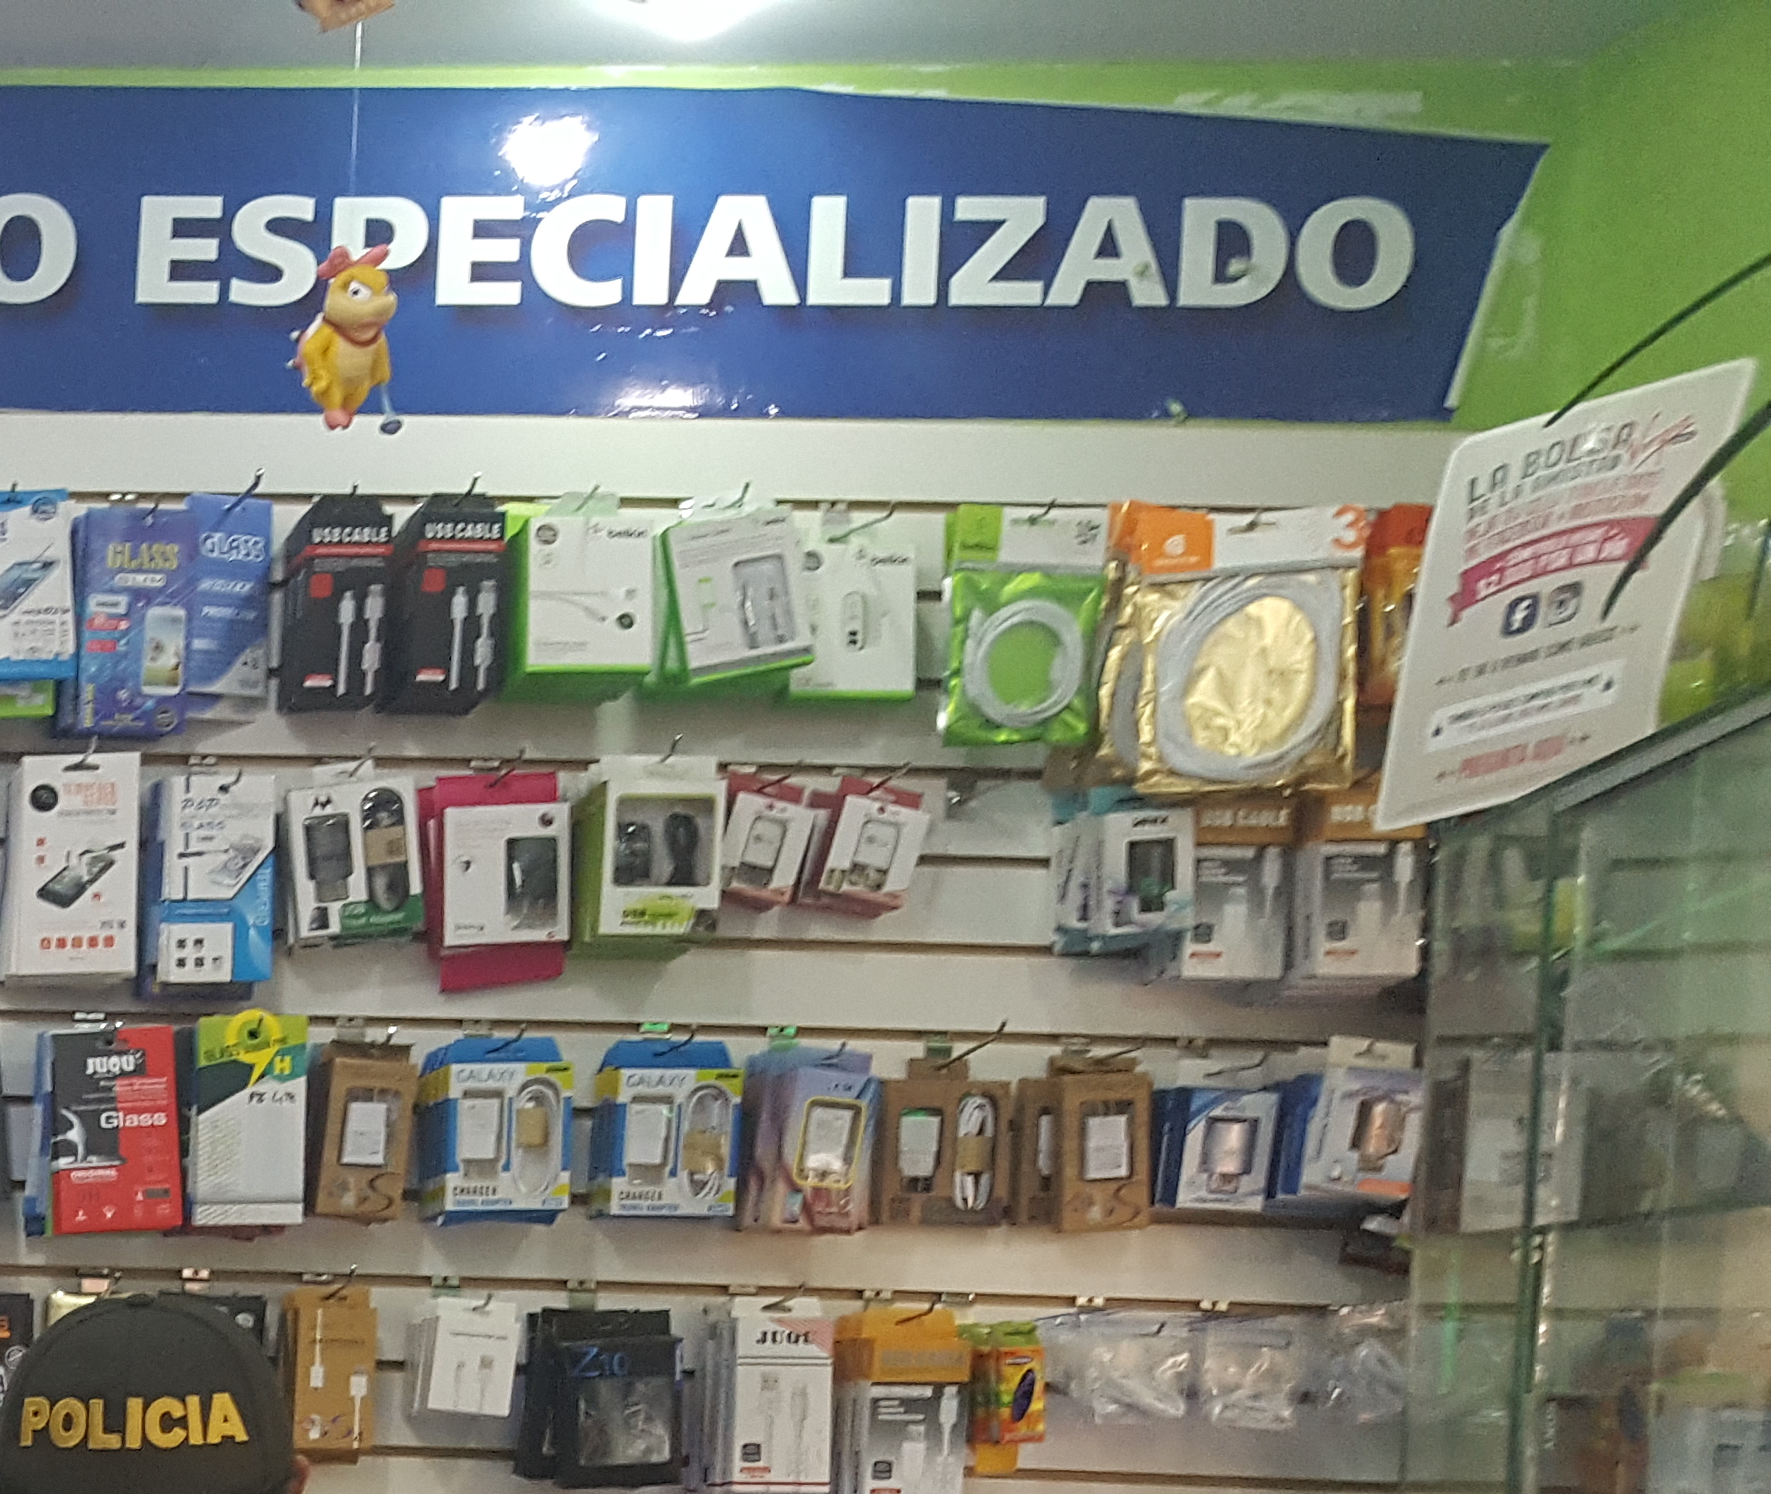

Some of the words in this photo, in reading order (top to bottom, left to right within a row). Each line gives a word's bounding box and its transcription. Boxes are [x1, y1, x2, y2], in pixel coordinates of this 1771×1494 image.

[134, 193, 1415, 311] ESPECIALIZADO
[107, 543, 181, 570] GLASS
[626, 1074, 687, 1089] GALAXY
[99, 1110, 169, 1131] Glass
[18, 1391, 249, 1450] POLICIA
